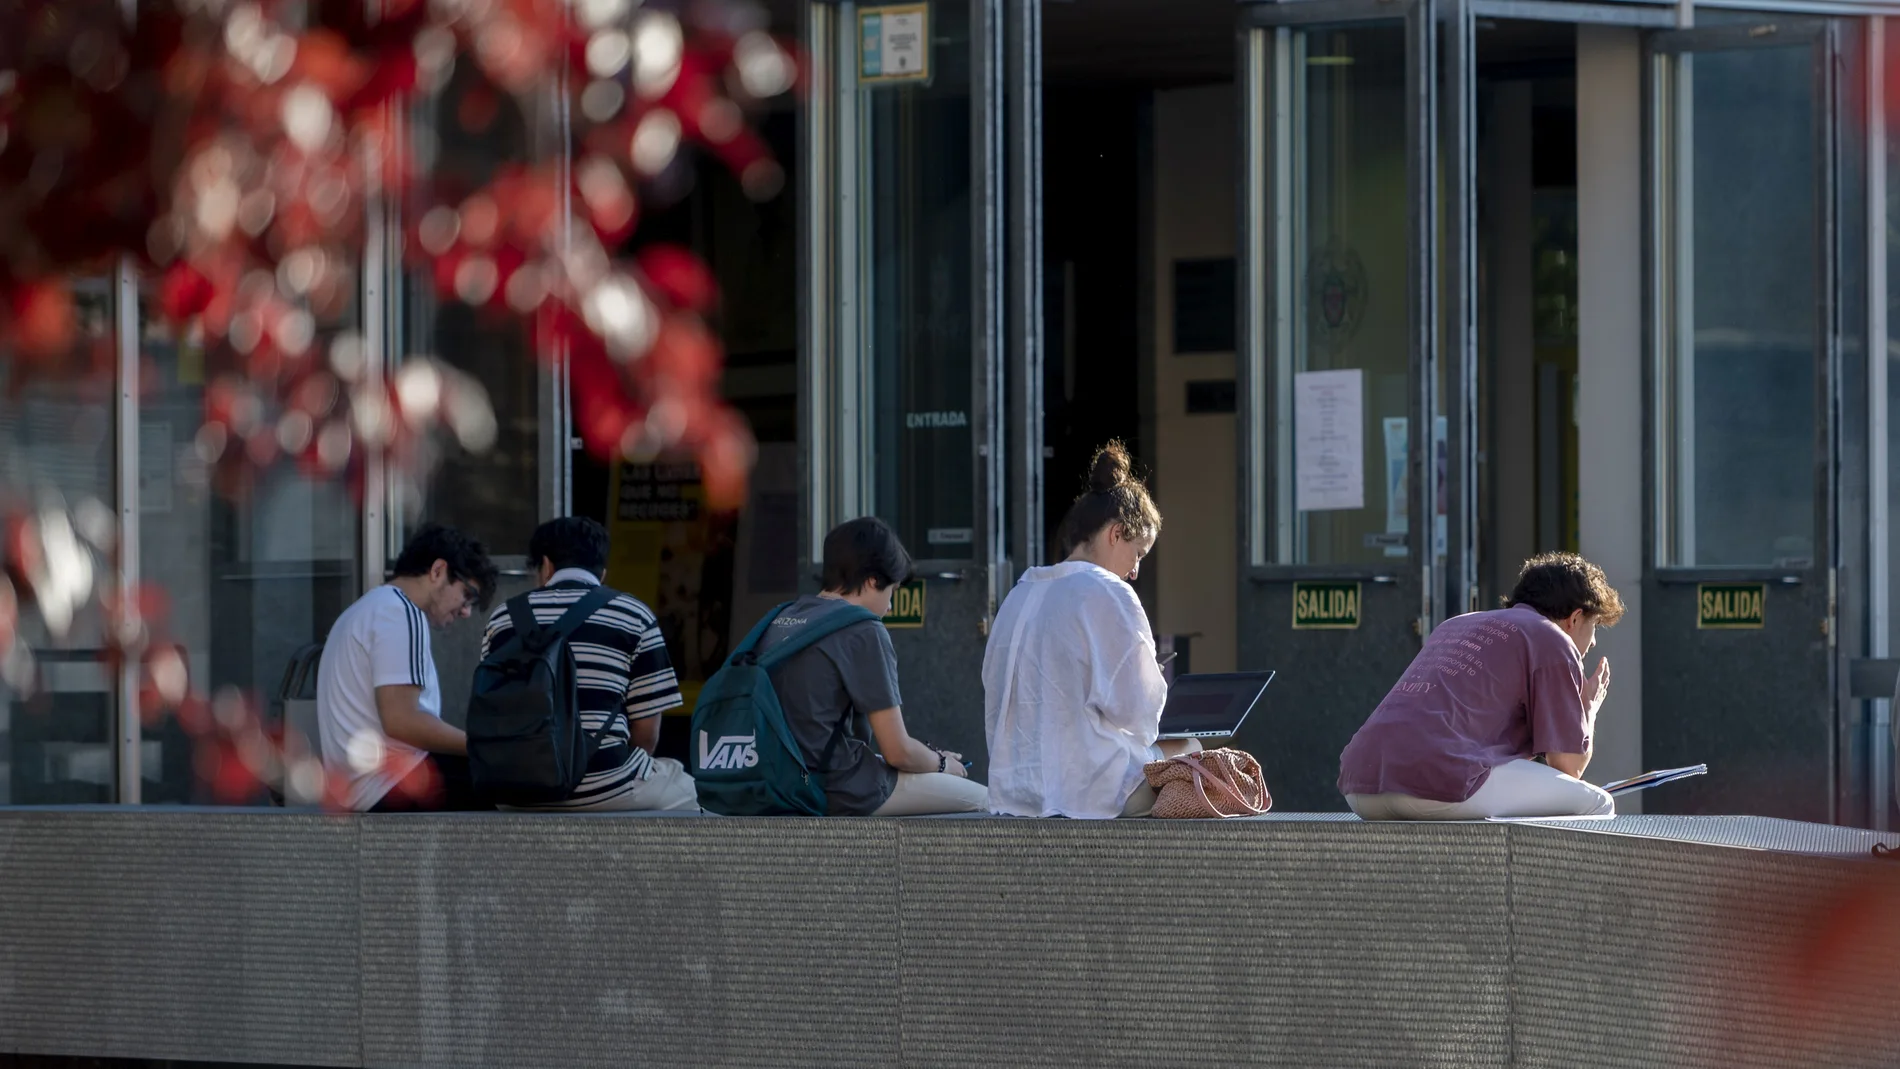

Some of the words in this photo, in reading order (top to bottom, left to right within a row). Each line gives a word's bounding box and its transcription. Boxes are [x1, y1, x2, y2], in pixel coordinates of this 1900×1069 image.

[906, 411, 967, 429] ENTRADA
[886, 587, 921, 617] IDA
[1298, 589, 1356, 619] SALIDA
[1703, 590, 1761, 619] SALIDA
[1508, 623, 1518, 632] to
[1484, 637, 1494, 645] to
[1467, 667, 1476, 676] to
[699, 728, 759, 769] VANS
